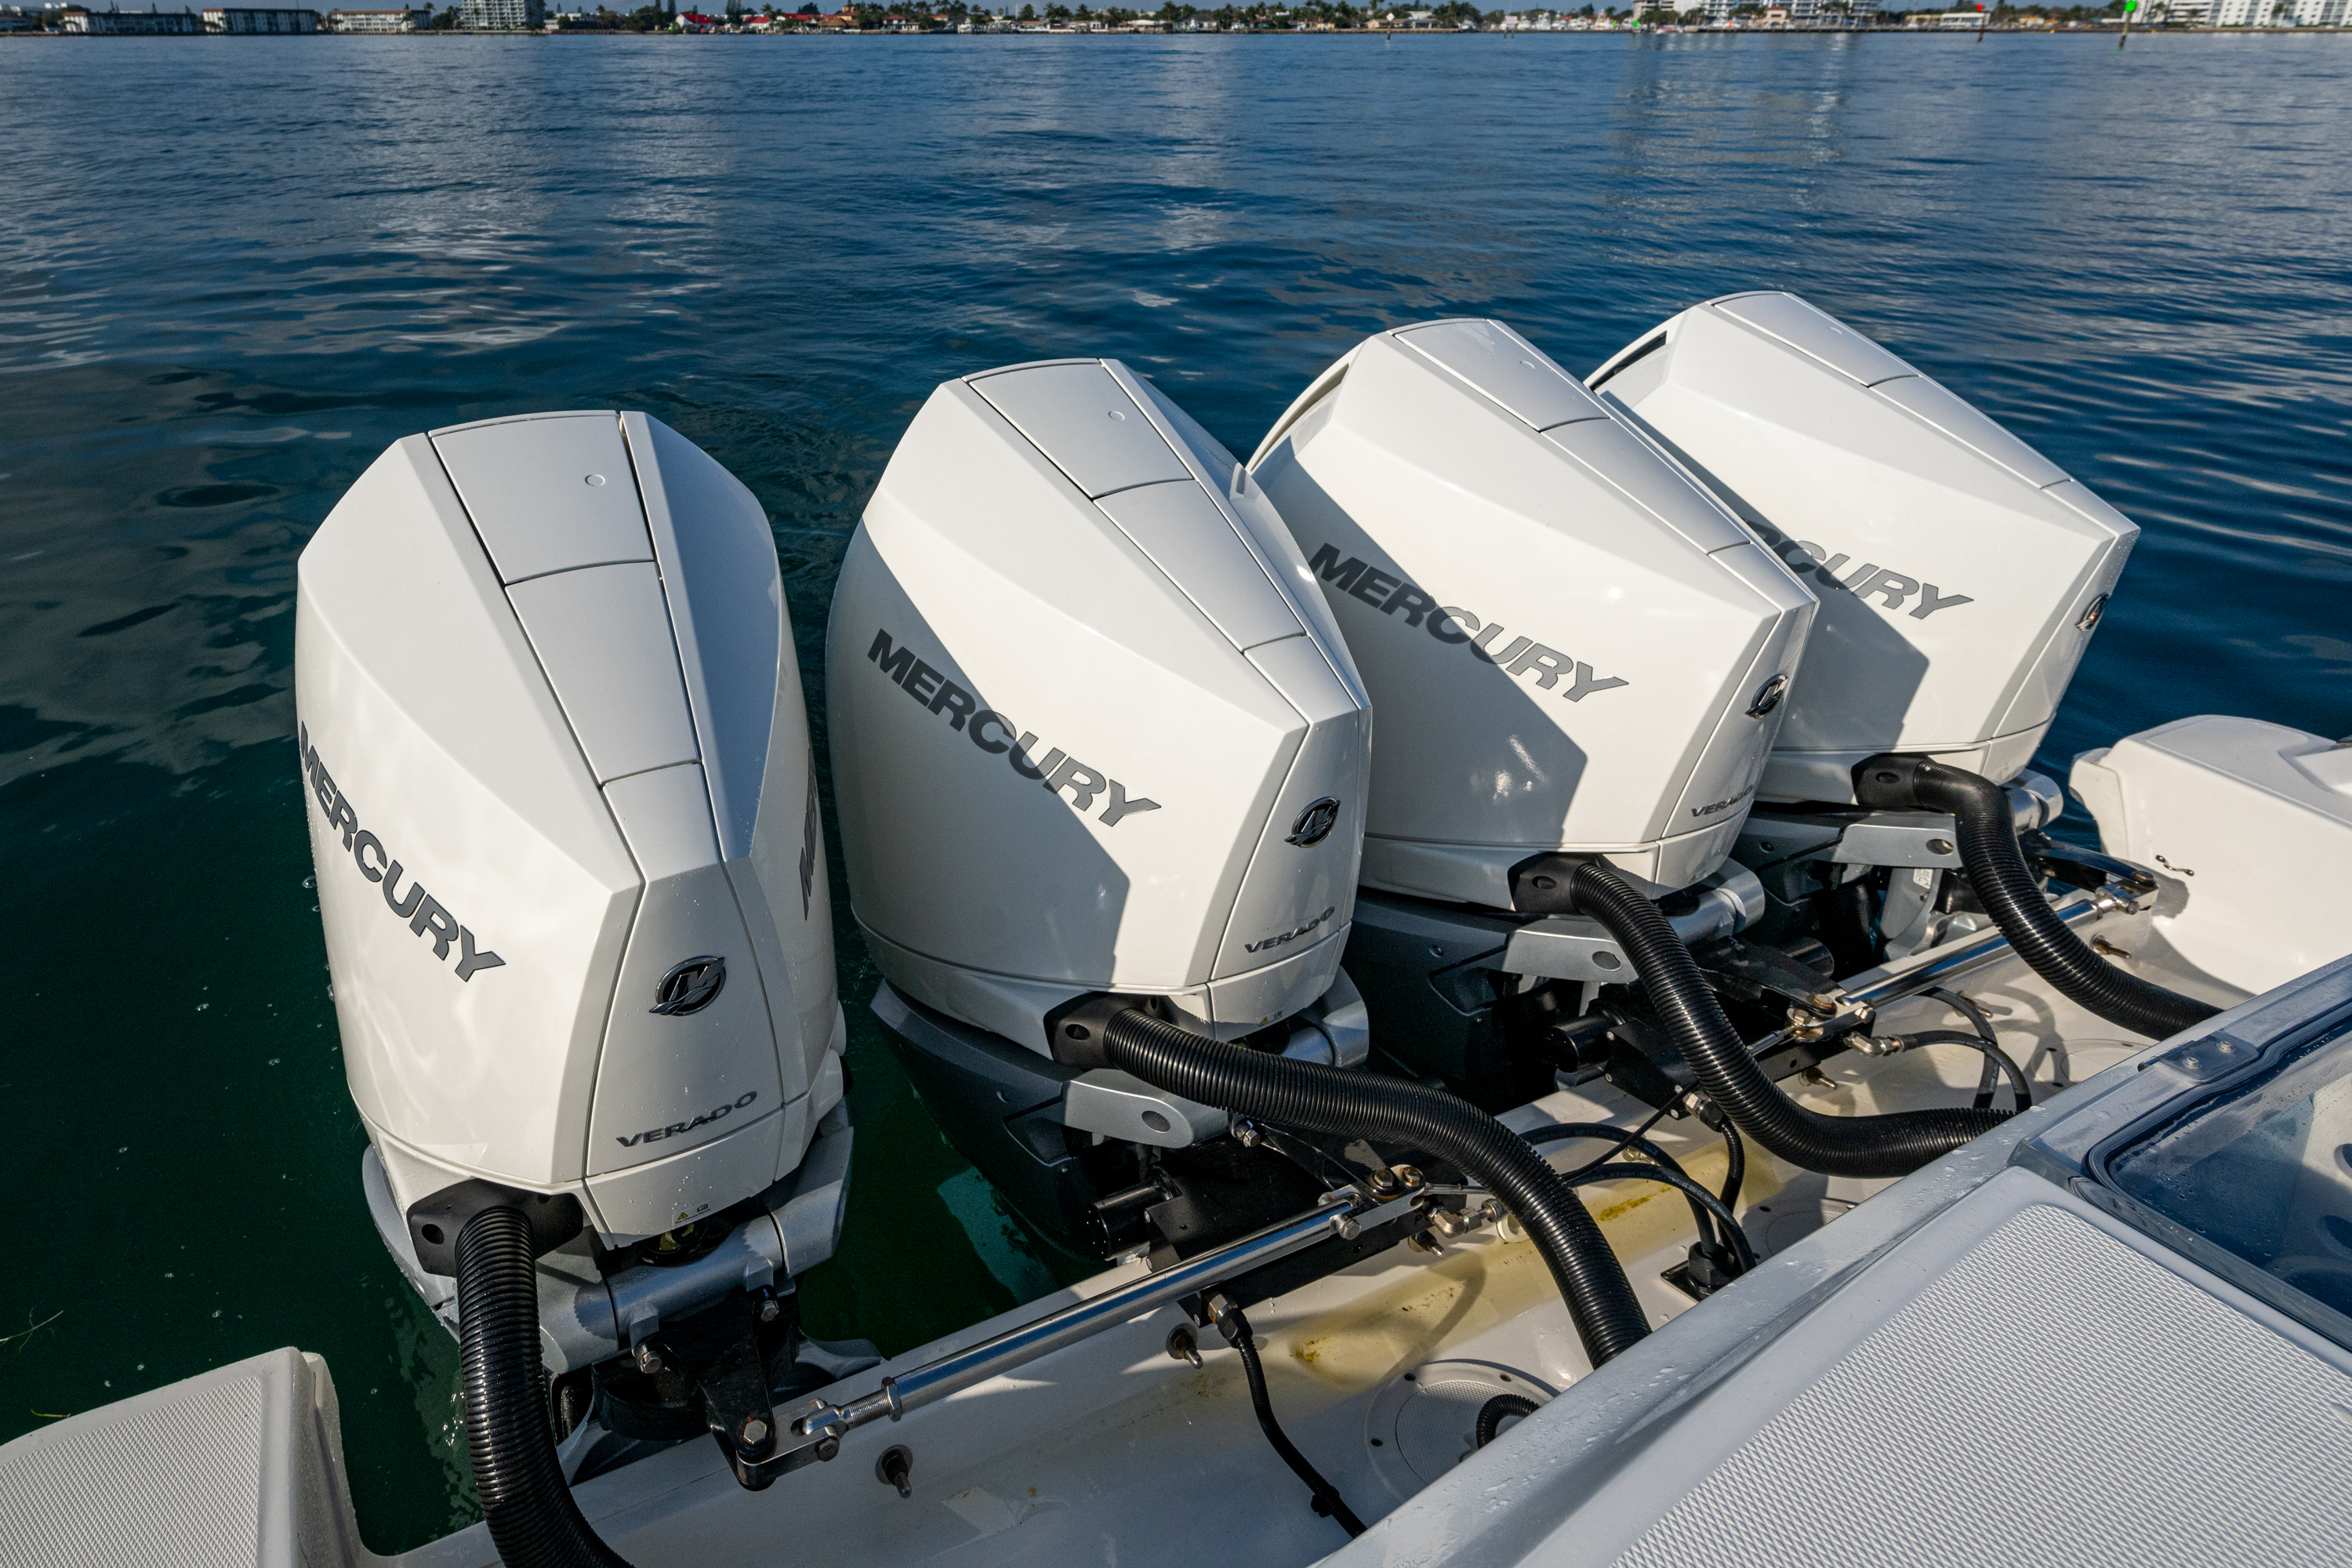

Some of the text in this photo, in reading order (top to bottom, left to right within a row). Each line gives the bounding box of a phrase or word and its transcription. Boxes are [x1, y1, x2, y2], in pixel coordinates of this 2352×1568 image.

[1308, 543, 1629, 702] MERCURY
[867, 628, 1161, 827] MERCURY
[300, 720, 506, 982] MERCURY
[1691, 784, 1755, 817] VERADO
[1243, 906, 1335, 953] VERADO
[615, 1091, 758, 1148] VERADO
